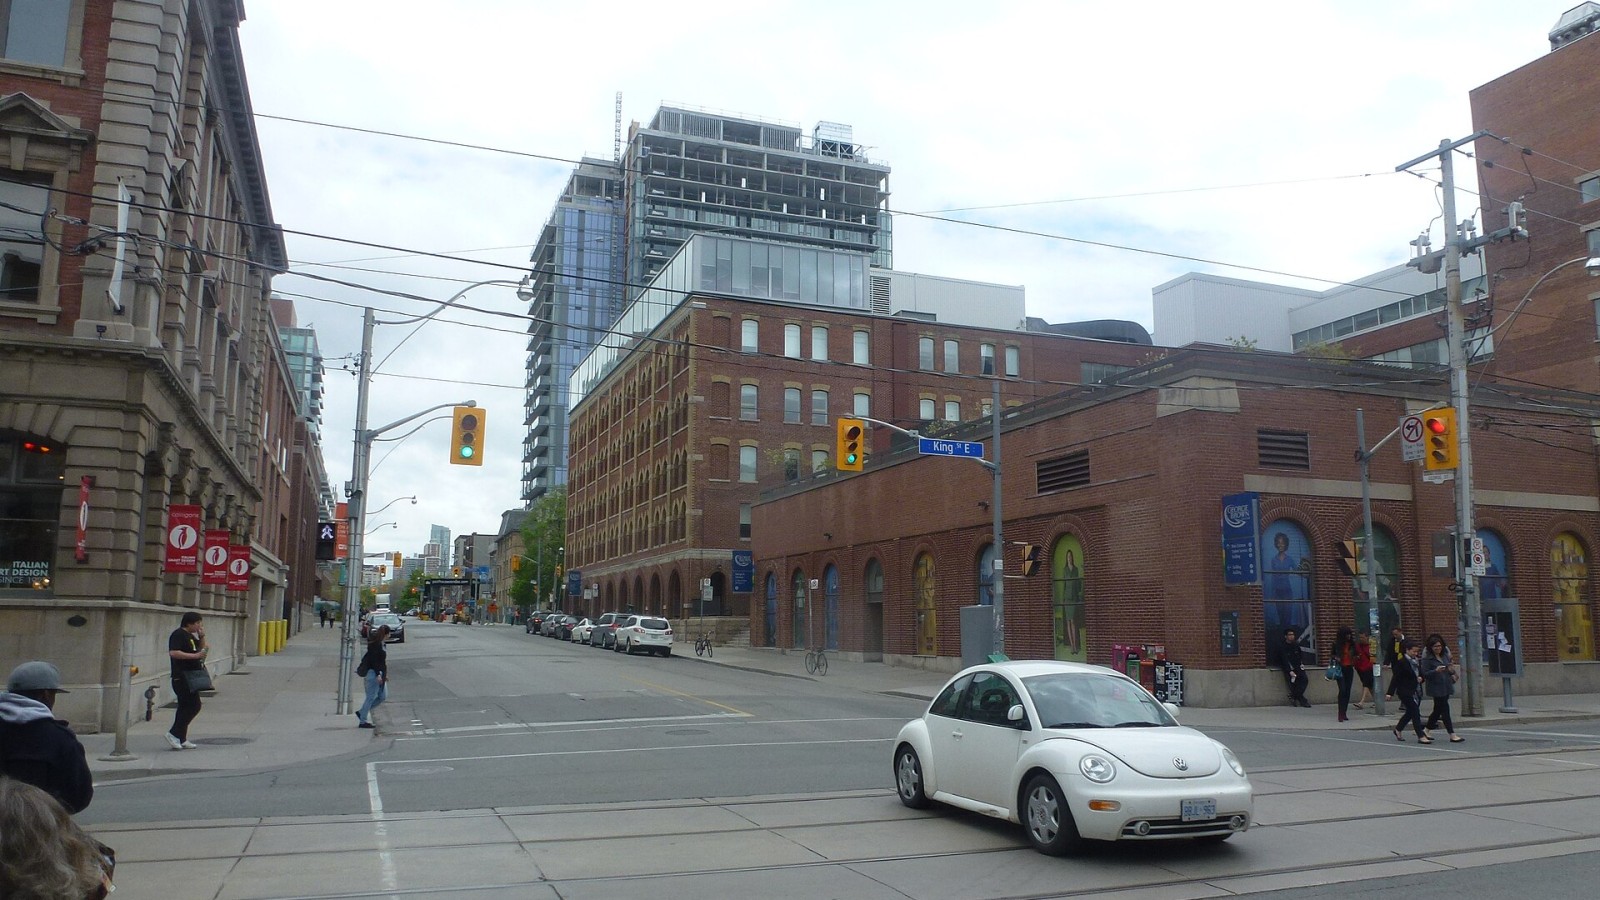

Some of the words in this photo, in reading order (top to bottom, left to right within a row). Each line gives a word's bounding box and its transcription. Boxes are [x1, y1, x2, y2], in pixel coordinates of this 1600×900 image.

[933, 441, 953, 454] King
[965, 444, 970, 453] E
[1226, 505, 1249, 513] GEORGE
[13, 561, 49, 569] ITALIAN
[12, 569, 48, 577] DESIGN
